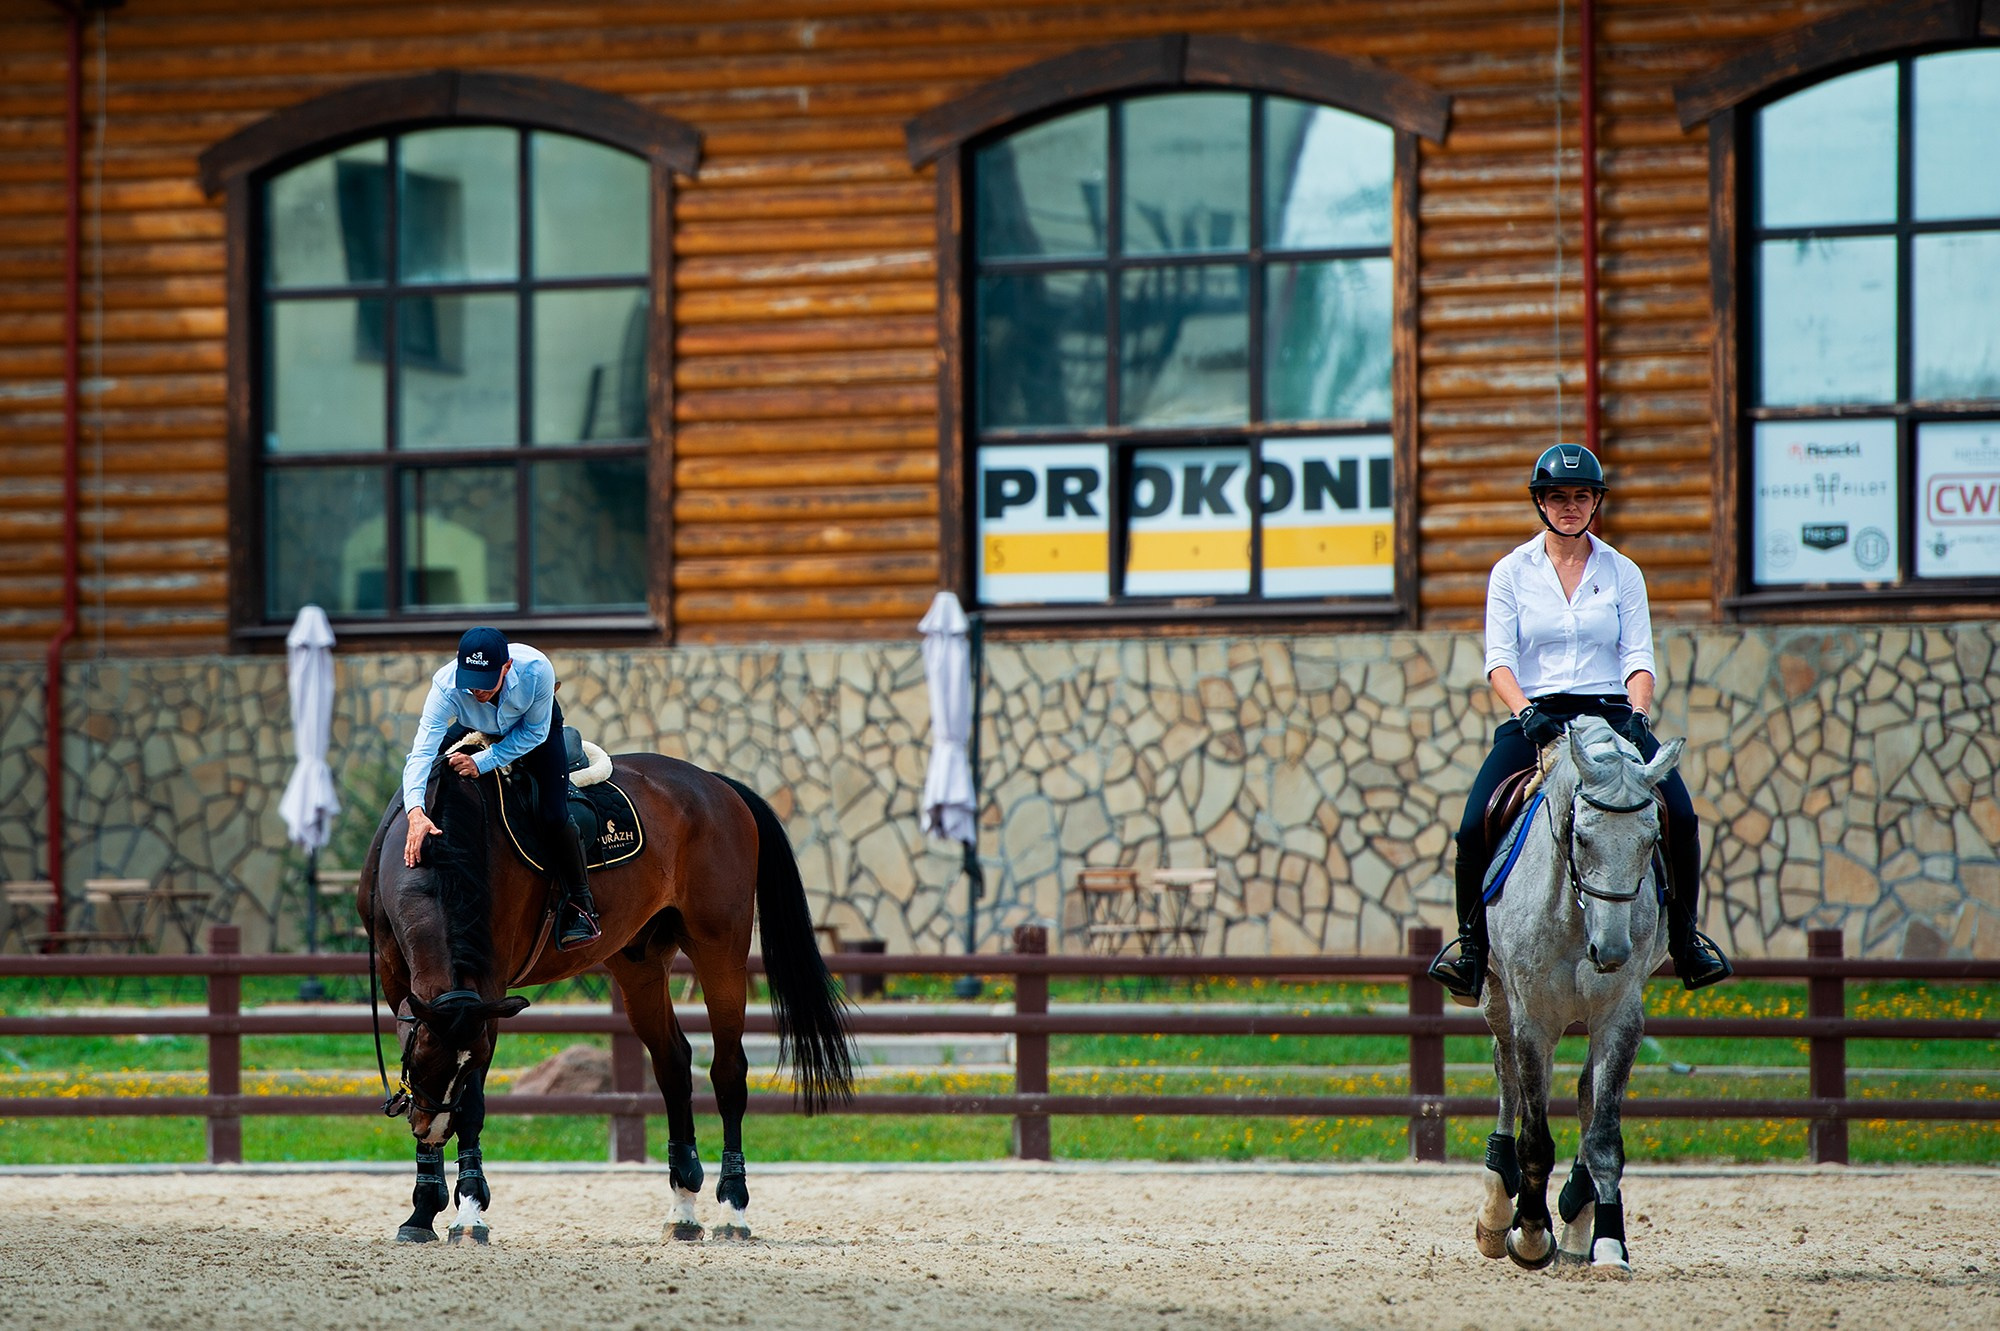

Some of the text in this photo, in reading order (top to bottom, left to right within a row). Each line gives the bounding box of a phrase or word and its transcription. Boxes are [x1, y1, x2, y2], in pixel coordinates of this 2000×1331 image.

[984, 457, 1393, 519] PROKONI
[1936, 482, 2000, 515] CW
[597, 831, 633, 844] URAZH
